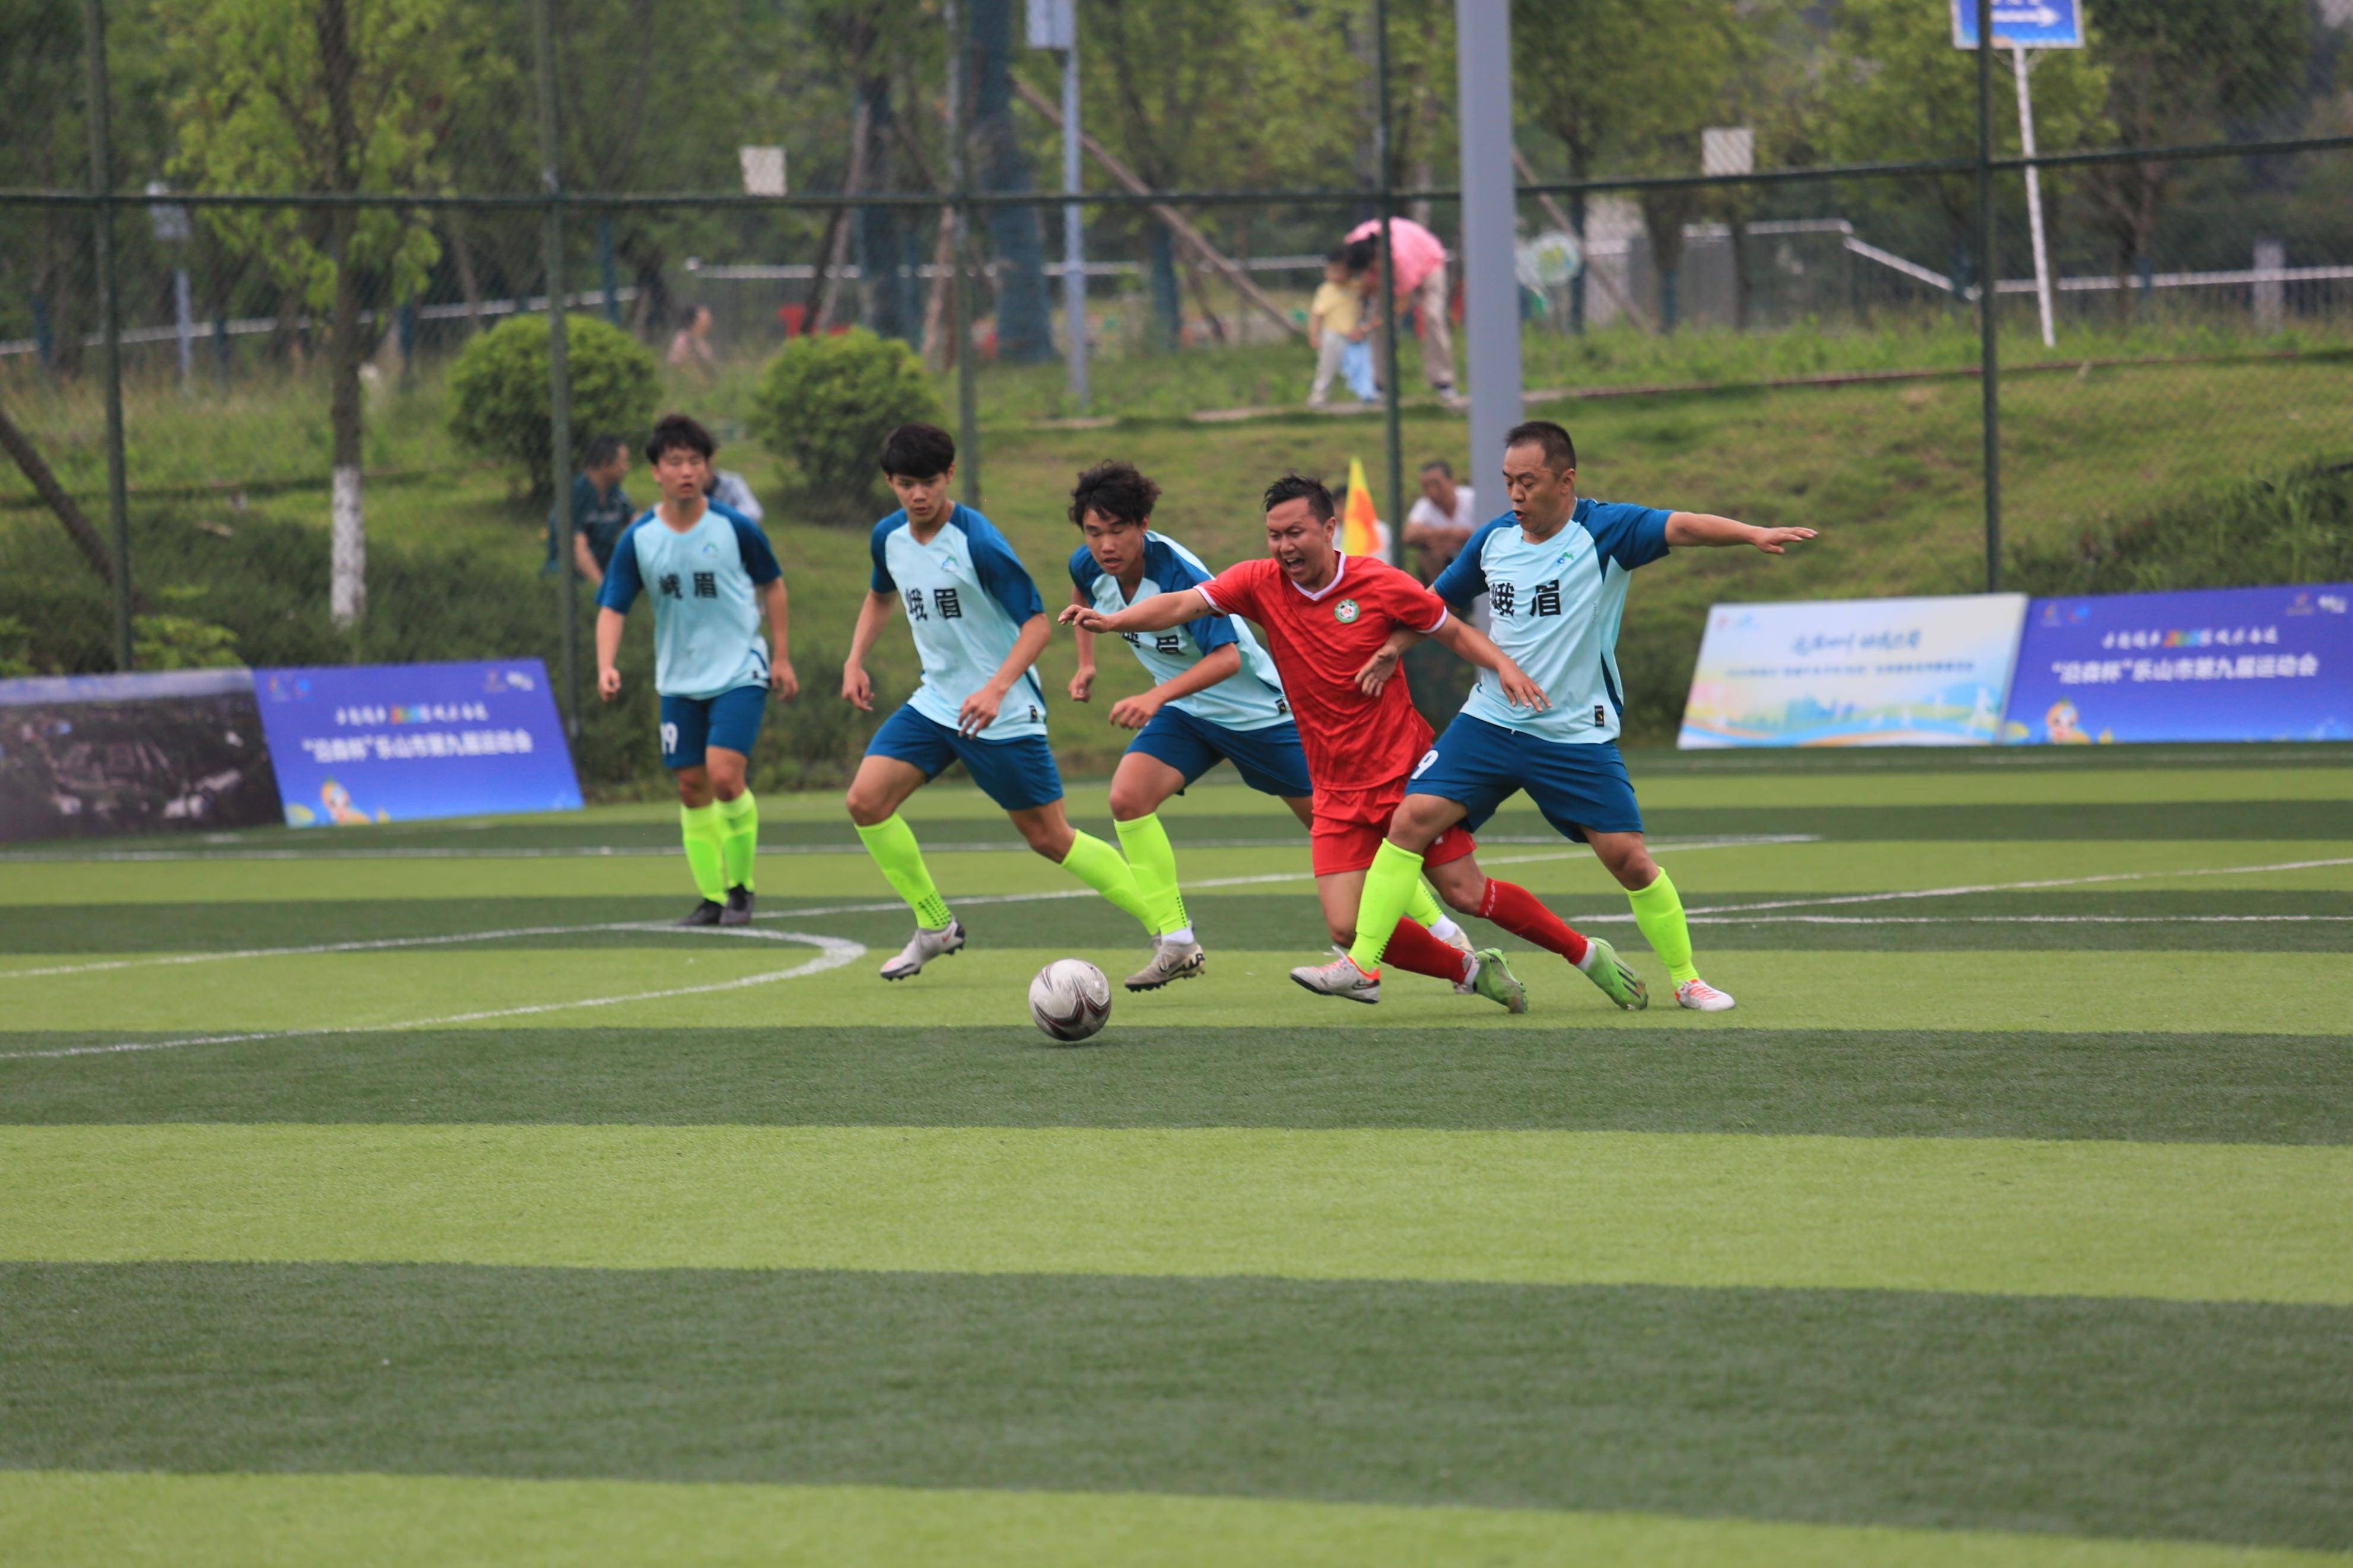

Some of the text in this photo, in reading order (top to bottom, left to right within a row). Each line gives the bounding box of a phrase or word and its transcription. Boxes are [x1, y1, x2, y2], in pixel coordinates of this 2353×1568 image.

[659, 572, 717, 600] 峨眉
[1490, 579, 1561, 618] 峨眉
[906, 588, 963, 621] 峨眉
